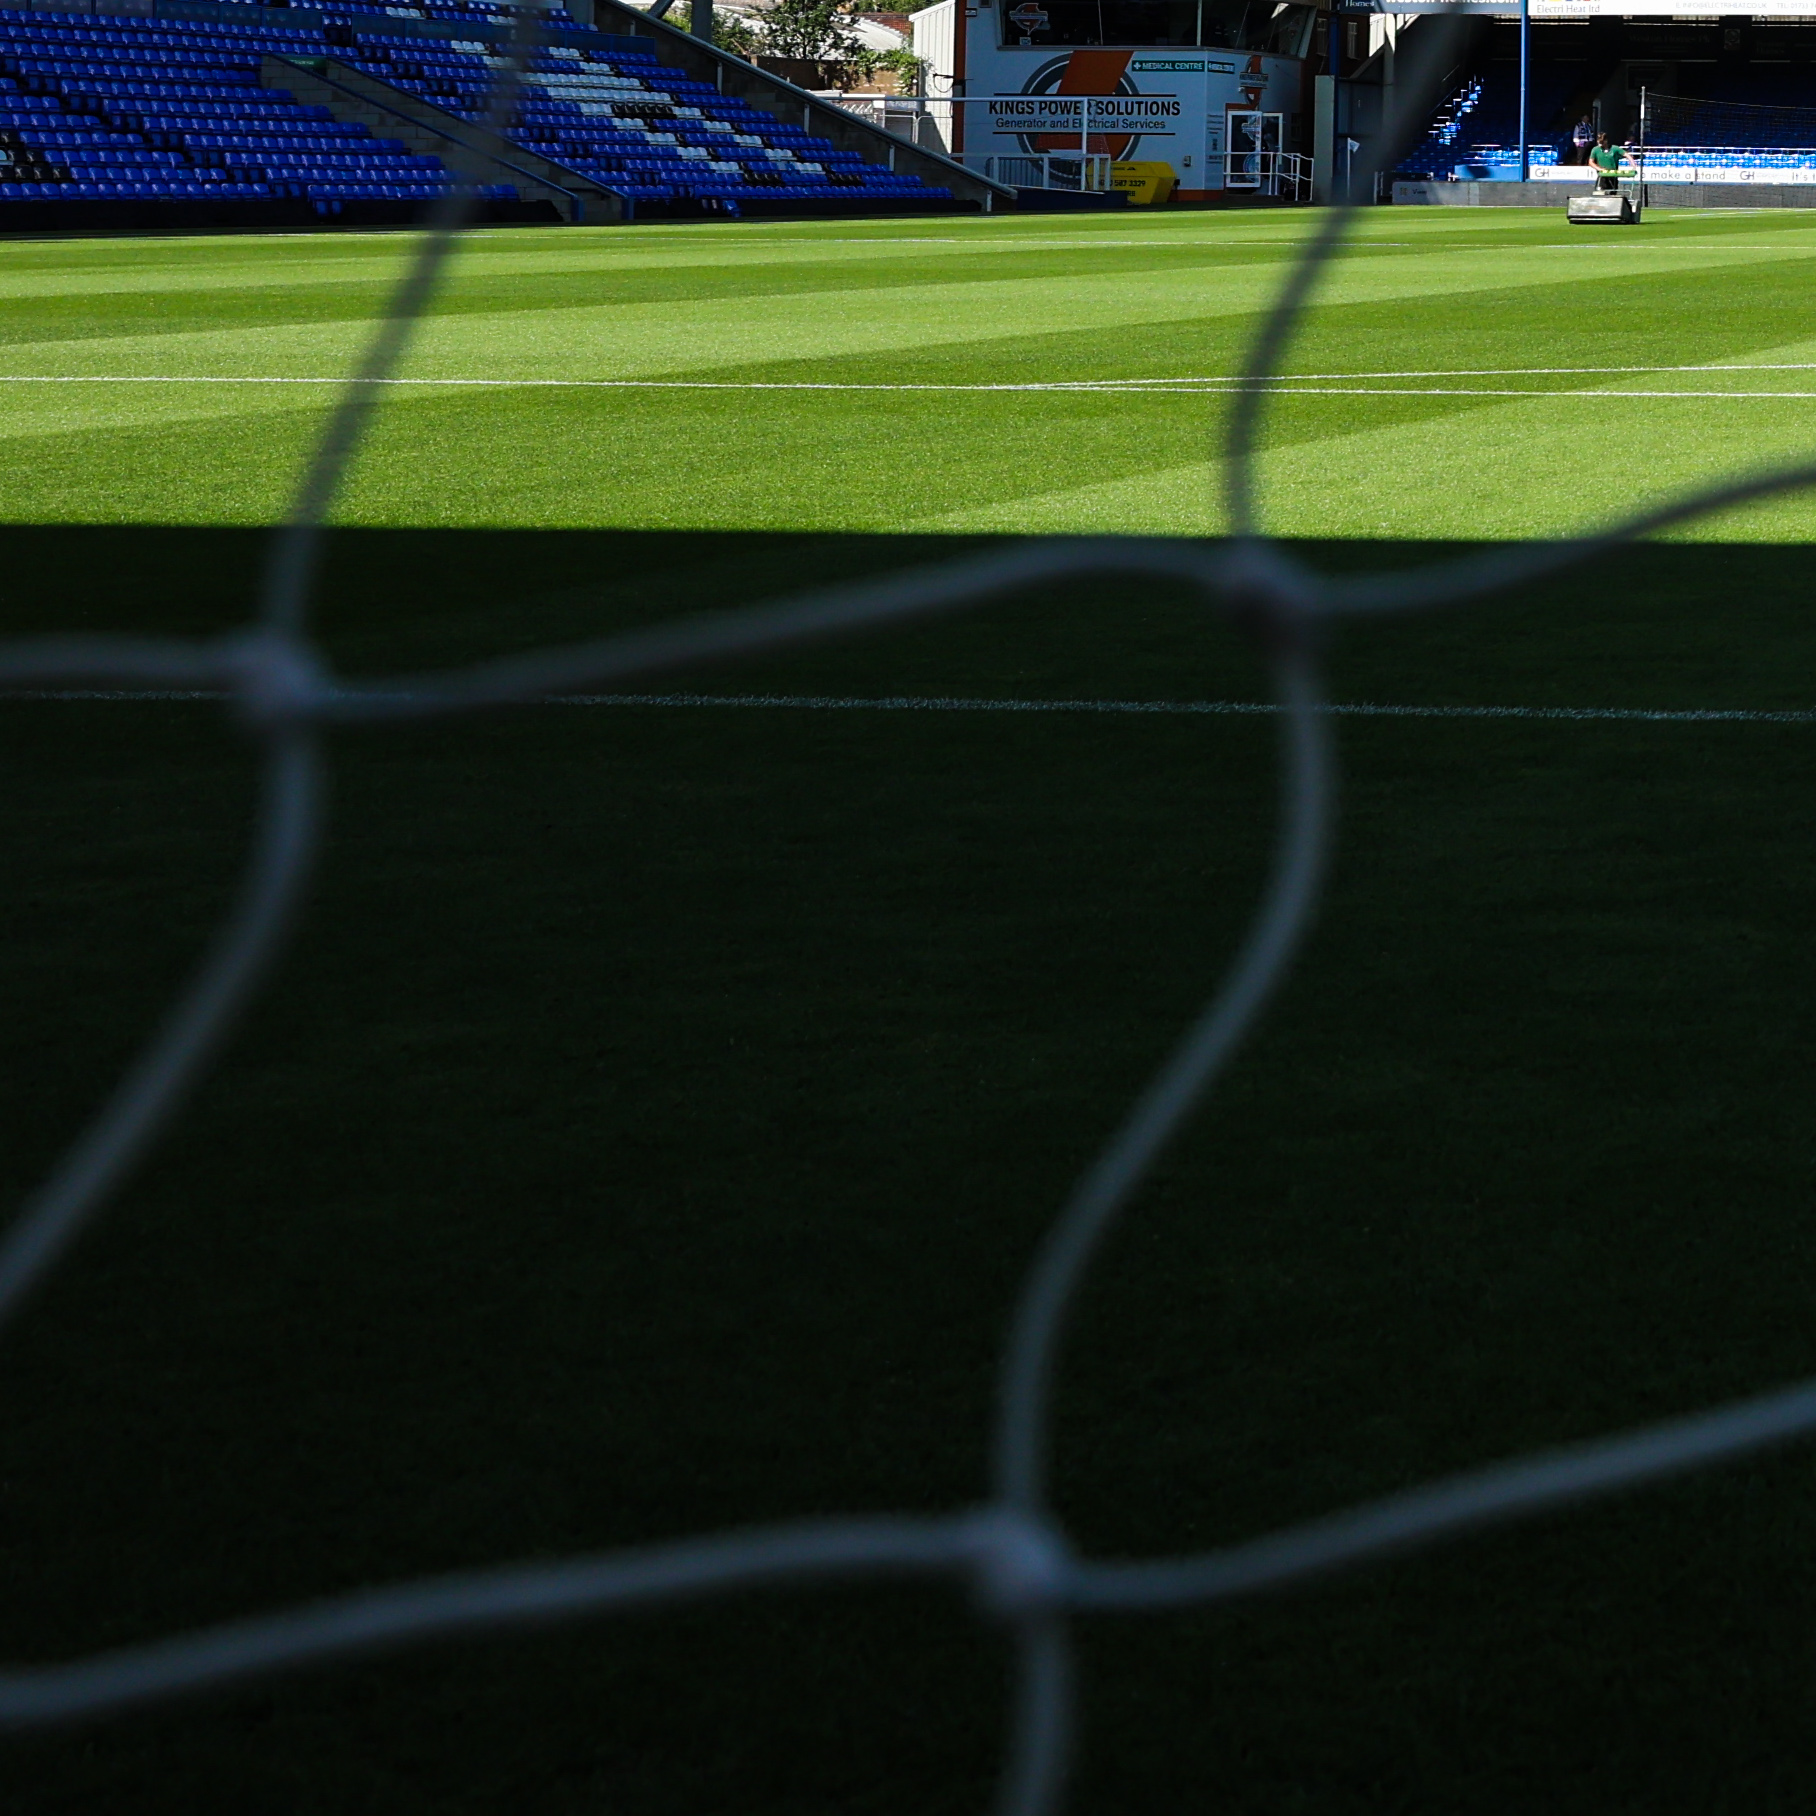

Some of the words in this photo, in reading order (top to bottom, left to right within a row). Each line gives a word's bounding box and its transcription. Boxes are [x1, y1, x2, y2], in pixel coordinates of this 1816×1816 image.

[1345, 0, 1375, 8] Homes
[1537, 4, 1563, 14] Electri
[1566, 4, 1586, 14] Heat
[1142, 62, 1174, 70] MEDICAL
[1176, 62, 1203, 70] CENTRE
[989, 100, 1035, 115] KINGS
[1096, 100, 1181, 116] SOLUTIONS
[996, 117, 1047, 129] Generator
[1050, 118, 1070, 129] and
[1072, 118, 1119, 129] Elctrical
[1122, 118, 1166, 130] Services
[1650, 171, 1680, 180] make
[1697, 171, 1726, 181] stand
[1792, 172, 1808, 182] It's
